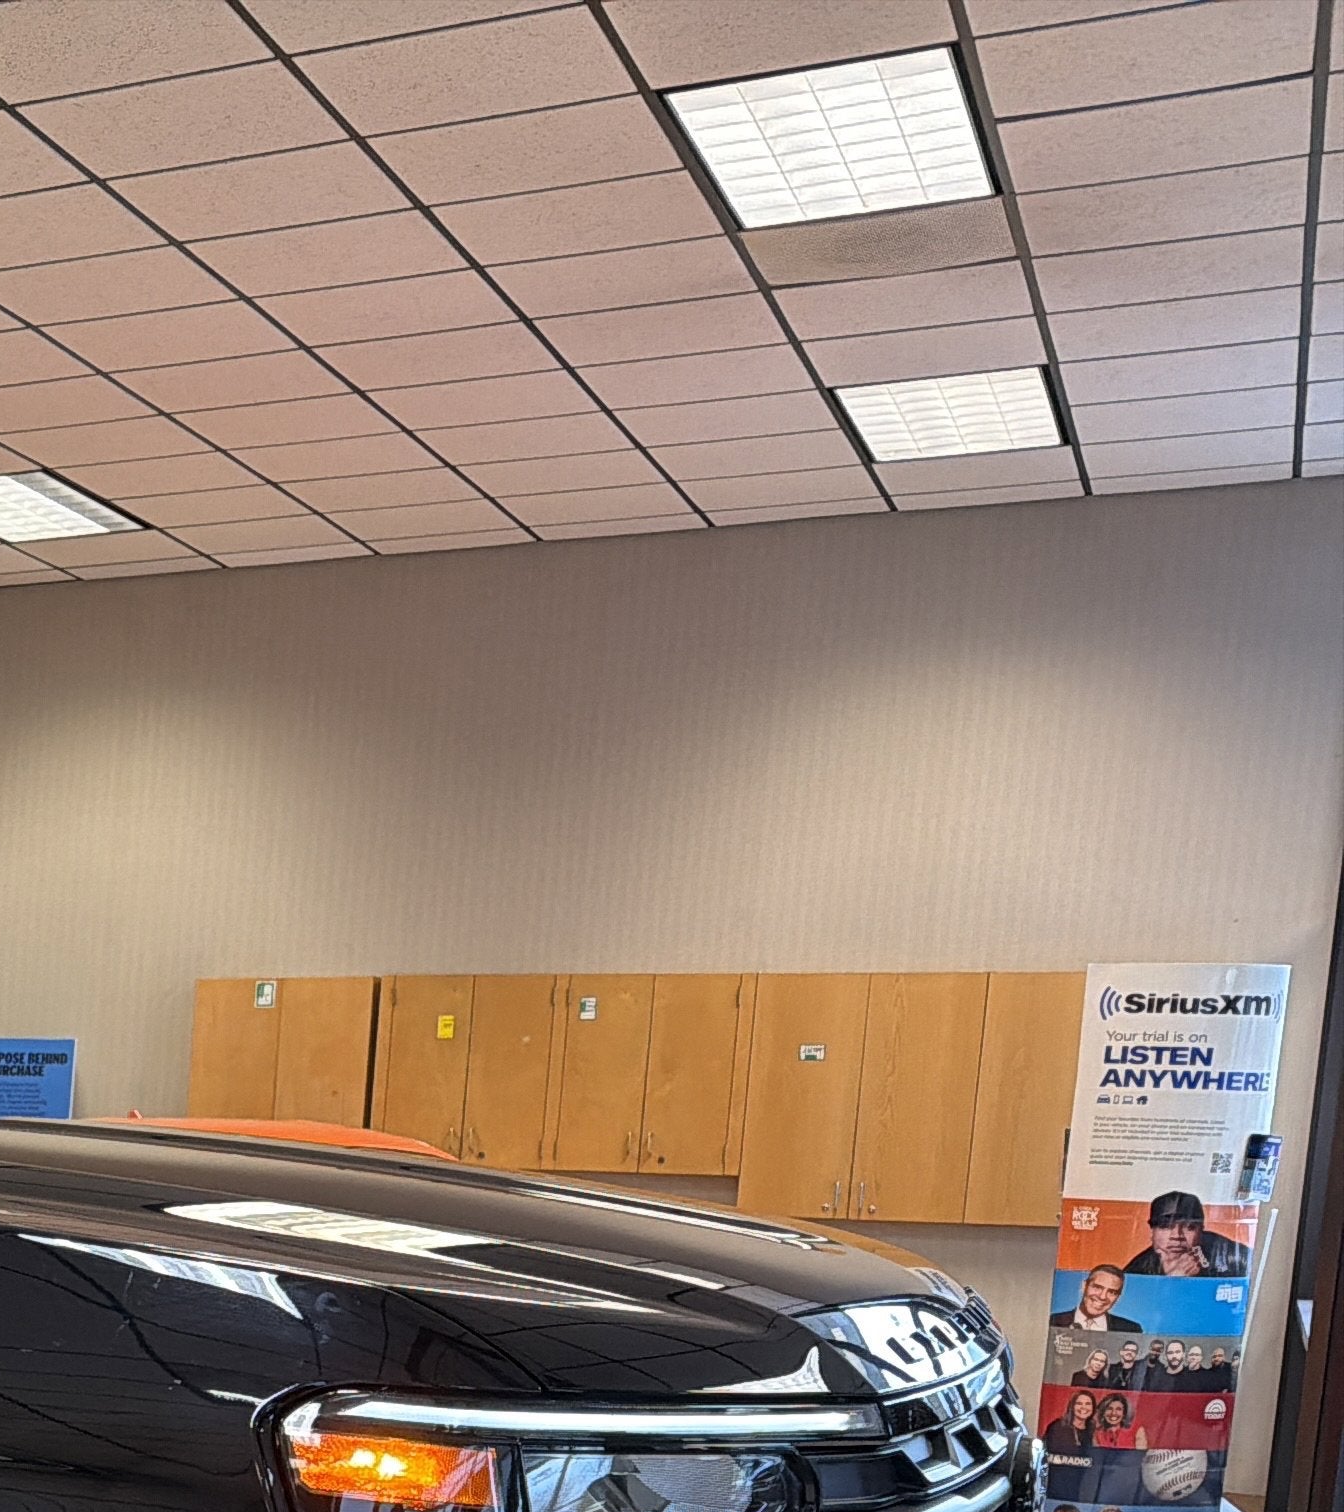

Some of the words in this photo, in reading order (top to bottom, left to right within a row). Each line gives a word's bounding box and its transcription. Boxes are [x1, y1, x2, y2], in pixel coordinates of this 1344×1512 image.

[1106, 1030, 1137, 1042] Your
[1142, 1031, 1169, 1042] trial
[1173, 1032, 1184, 1043] is
[1188, 1033, 1208, 1043] on
[28, 1053, 68, 1066] BEHIND
[1103, 1045, 1214, 1067] LISTEN
